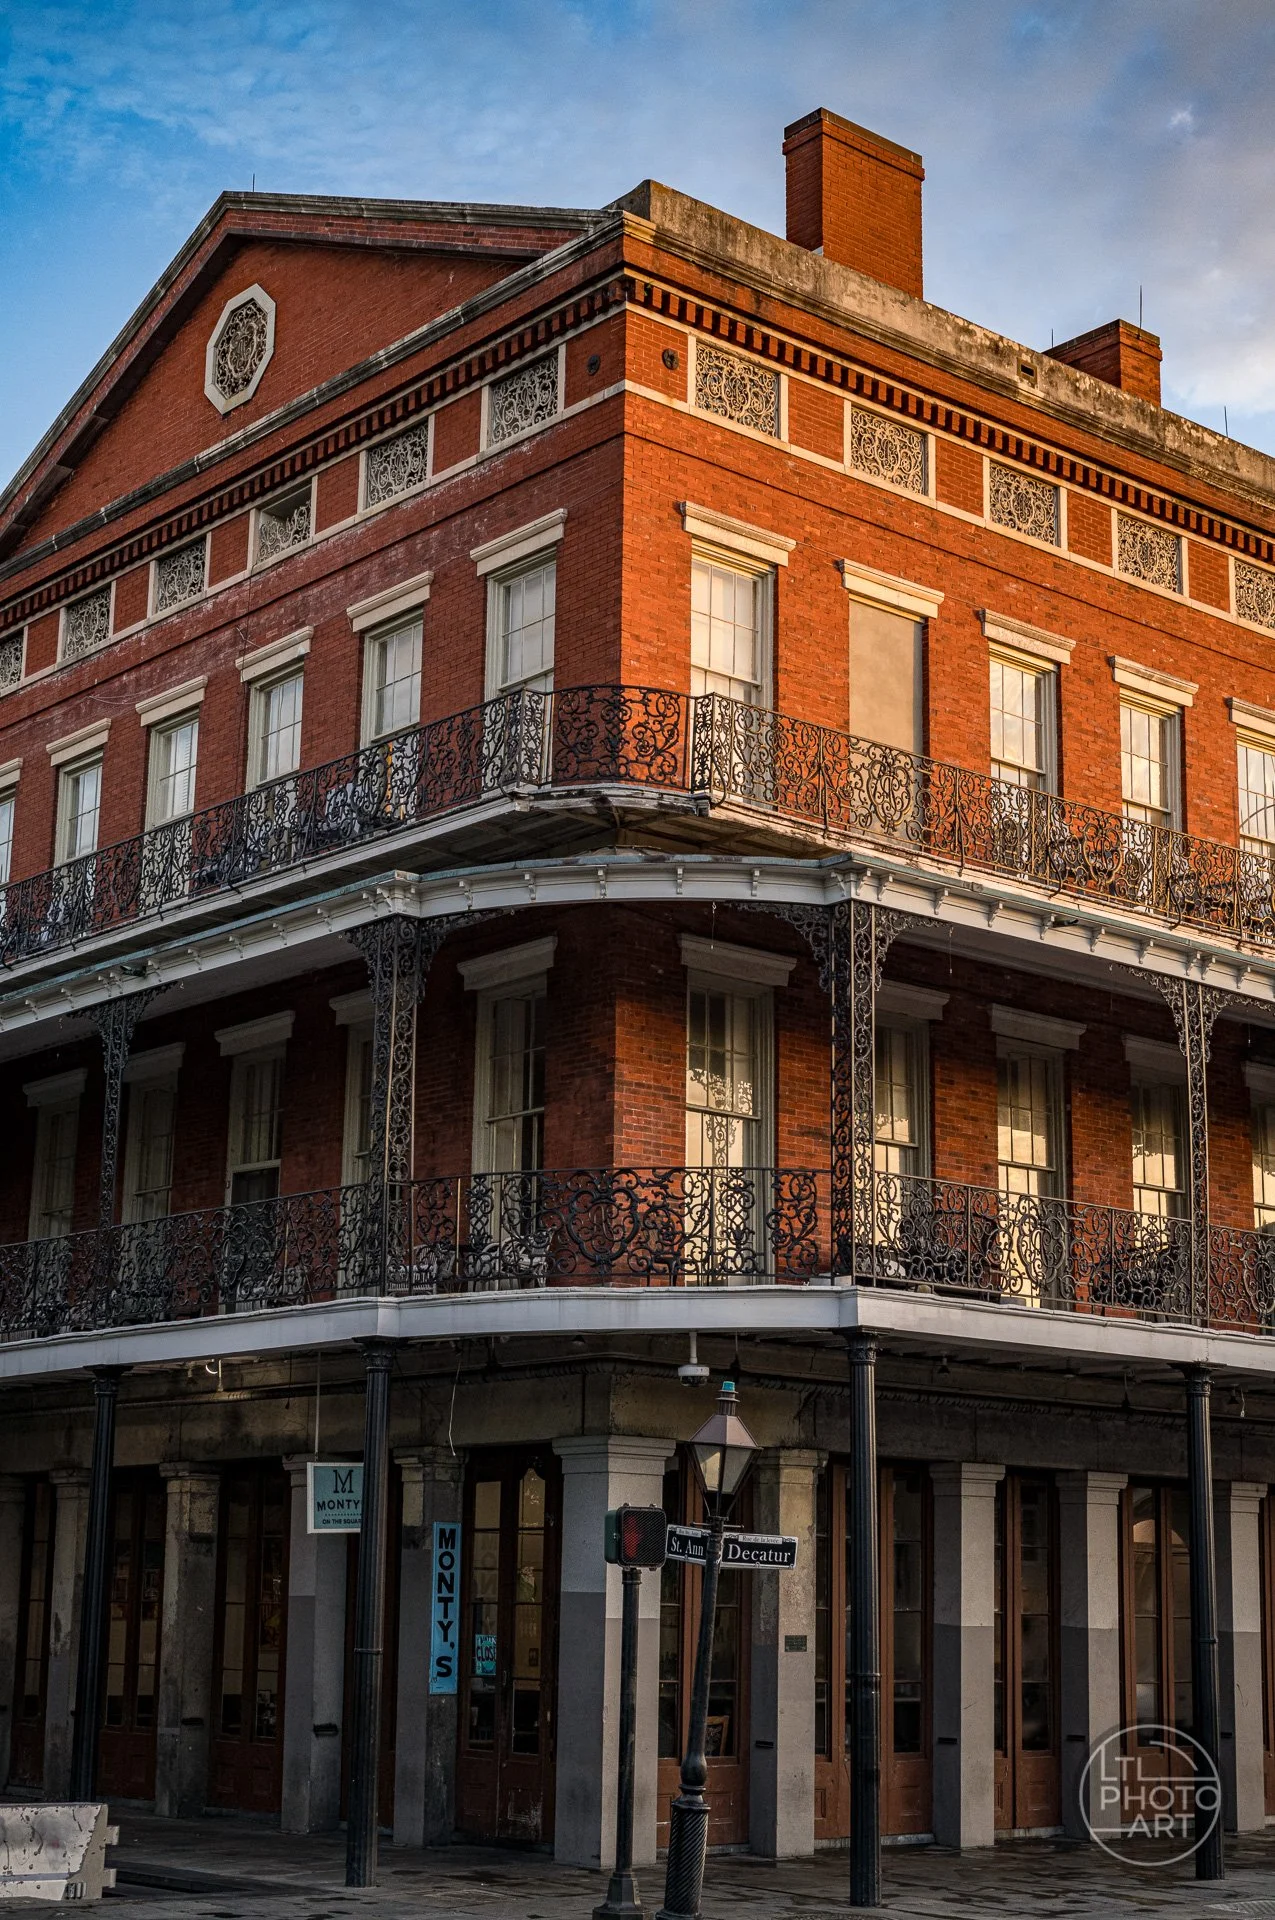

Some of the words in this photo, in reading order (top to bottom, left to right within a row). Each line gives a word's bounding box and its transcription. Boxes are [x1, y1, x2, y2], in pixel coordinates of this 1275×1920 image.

[332, 1469, 354, 1494] M
[316, 1499, 360, 1513] MONTY
[670, 1536, 682, 1553] St.
[685, 1539, 704, 1556] Ann
[727, 1543, 791, 1563] Decatur
[436, 1527, 457, 1678] MONTY'S
[477, 1646, 496, 1661] CLOS
